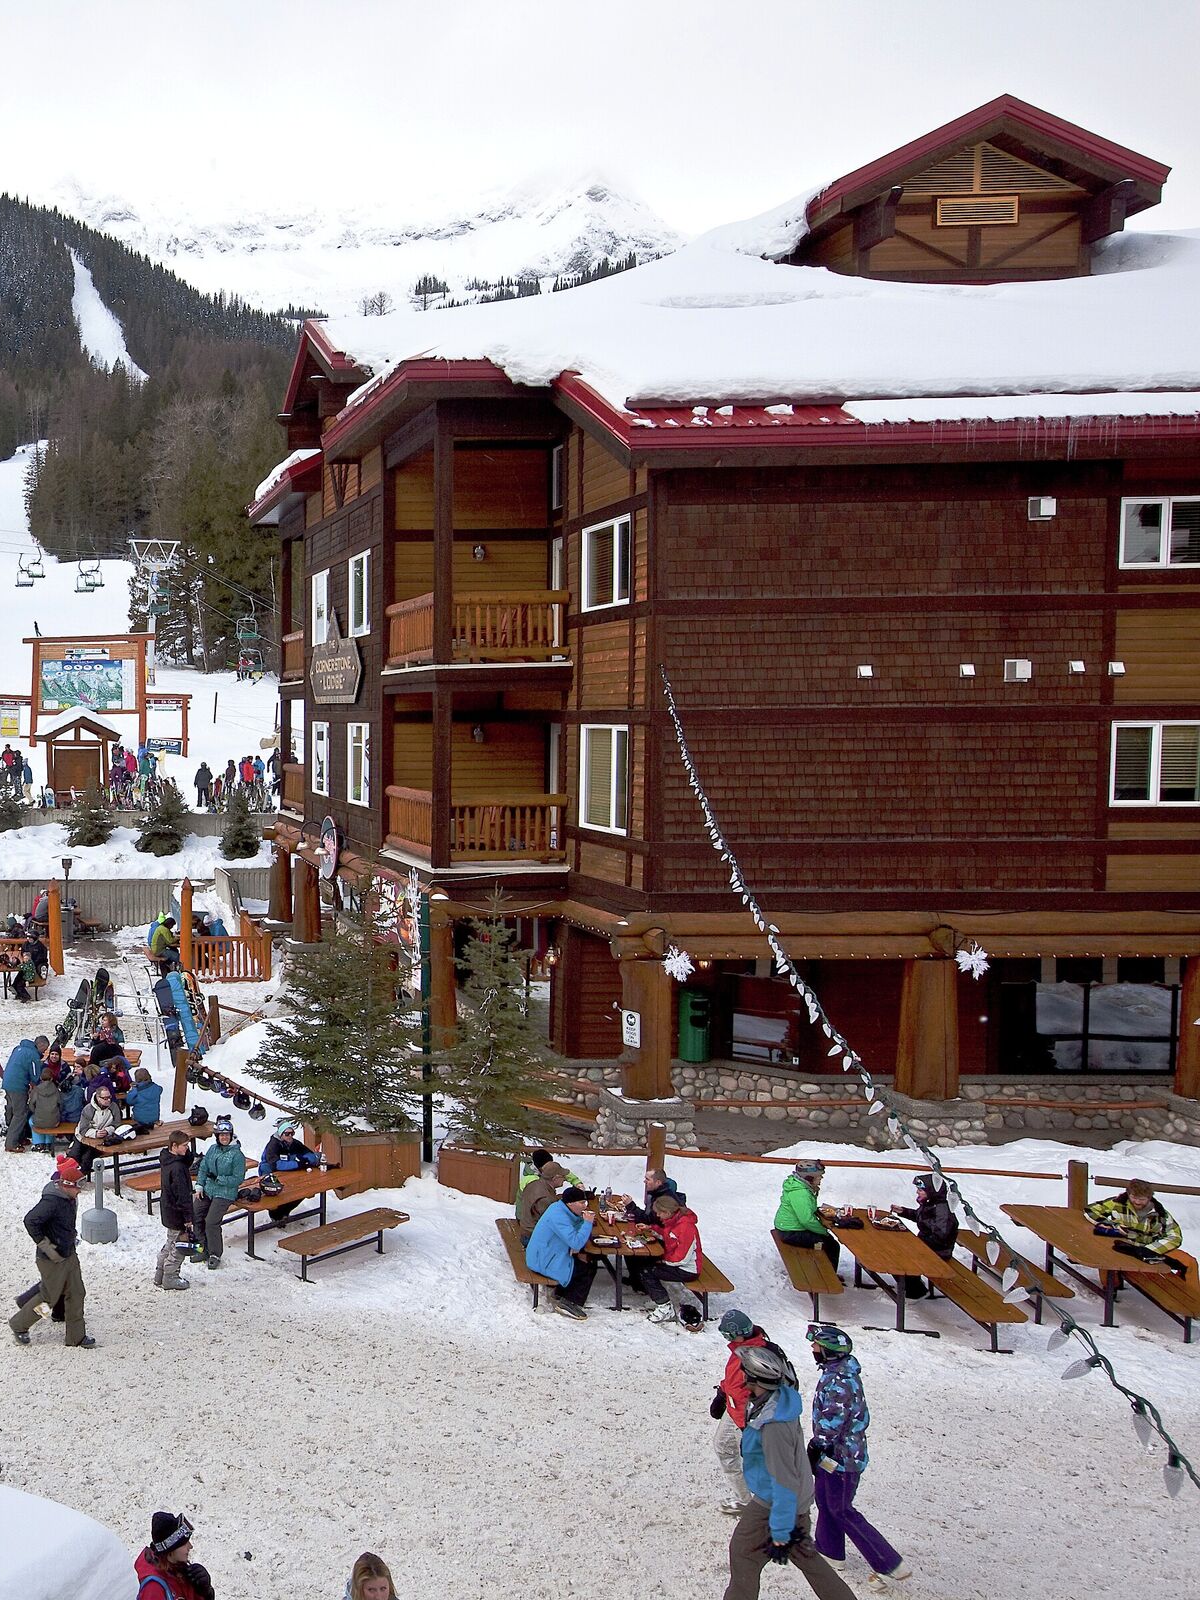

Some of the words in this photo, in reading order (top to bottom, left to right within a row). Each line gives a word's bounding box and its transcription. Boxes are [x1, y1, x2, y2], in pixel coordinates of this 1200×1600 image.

[315, 656, 351, 673] CORNERSTONE
[322, 673, 343, 690] LODGE
[150, 739, 179, 747] NONSTOP
